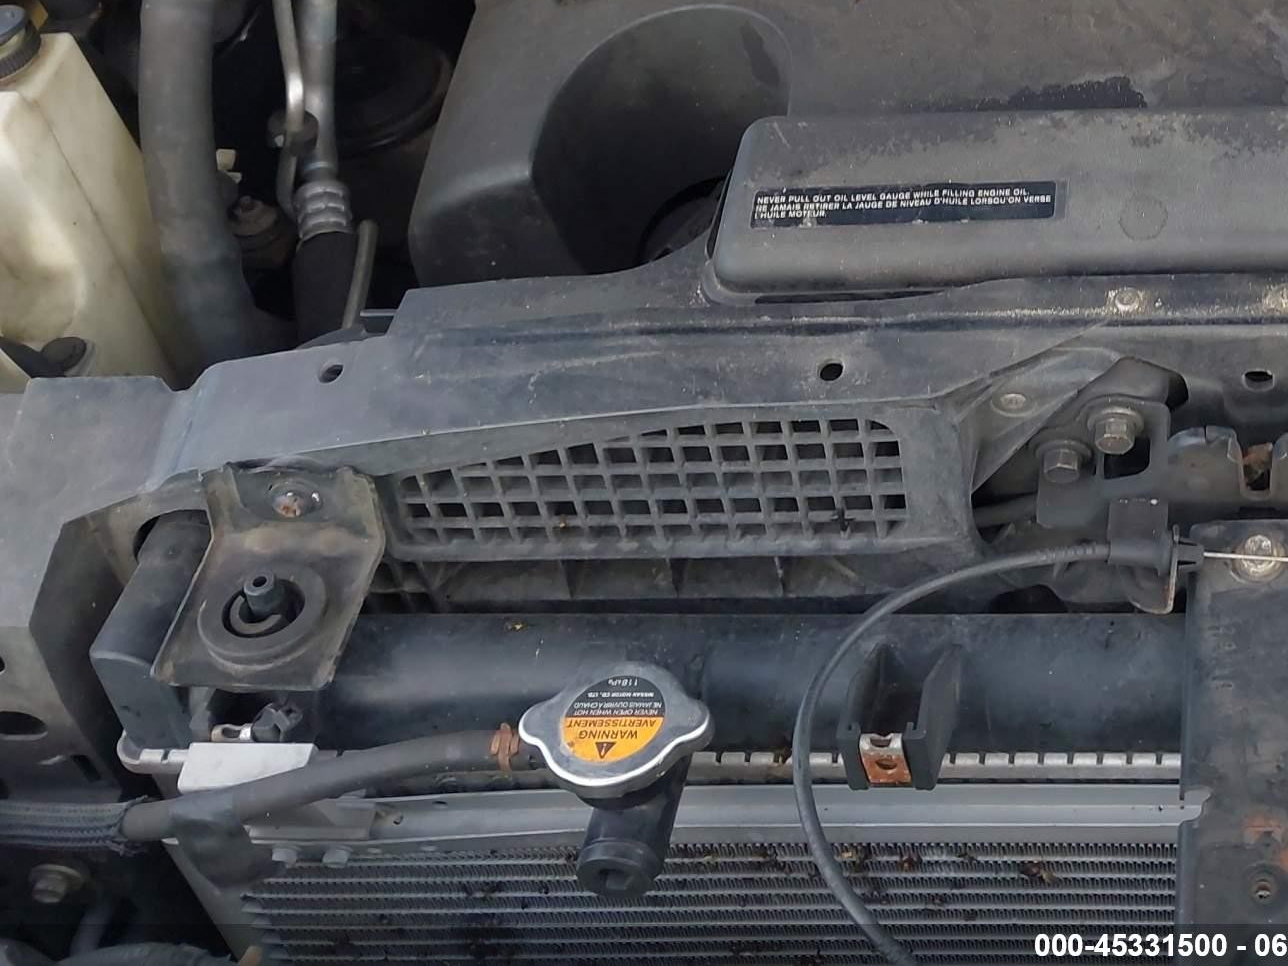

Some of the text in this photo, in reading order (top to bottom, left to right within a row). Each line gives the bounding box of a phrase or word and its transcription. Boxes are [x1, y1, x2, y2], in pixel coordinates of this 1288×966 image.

[757, 188, 1030, 204] NEVER PULL OUT OIL LEVEL GAUGE WHILE FILLING ENGINE OIL.
[755, 194, 1052, 212] NE JAMAIS RETIRER LA JAUGE DE NIVEAU D'HUILE LORSQU'ON VERSE
[754, 211, 786, 220] LHUILE
[613, 708, 633, 716] OPEN
[634, 708, 659, 716] NEVER
[566, 718, 657, 728] AVERTISSEMENT
[578, 730, 638, 740] WARNING
